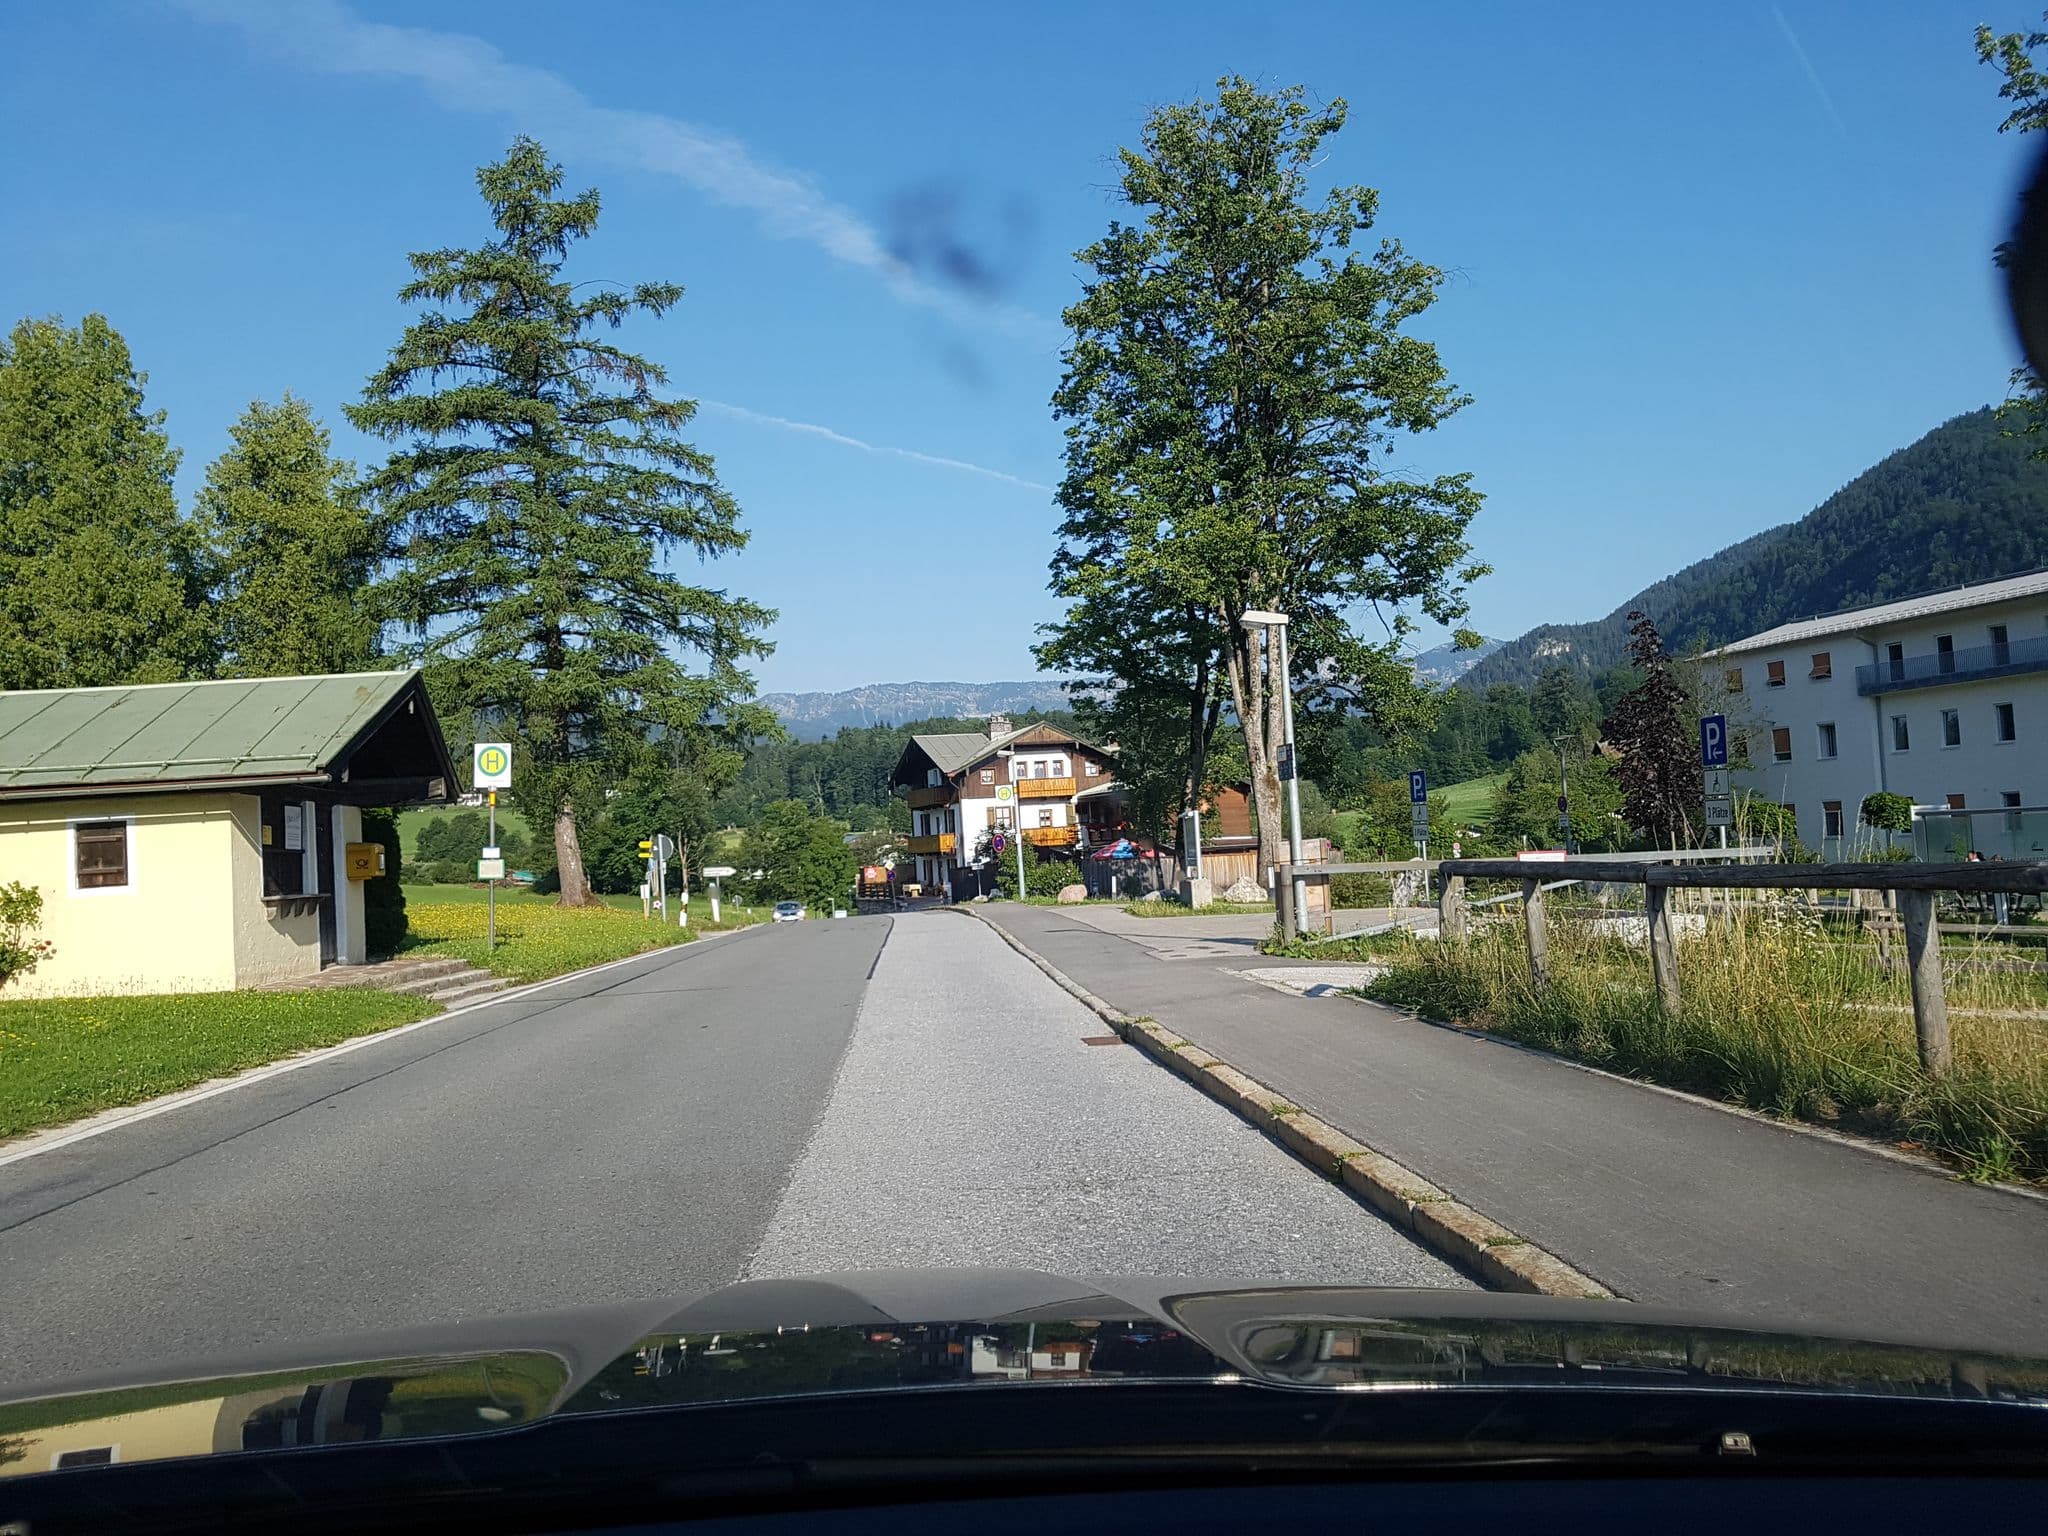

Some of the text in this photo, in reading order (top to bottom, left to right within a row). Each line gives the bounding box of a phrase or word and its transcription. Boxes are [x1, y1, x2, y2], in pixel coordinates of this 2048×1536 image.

[1706, 722, 1720, 760] P
[487, 753, 499, 770] H
[1413, 775, 1422, 799] P
